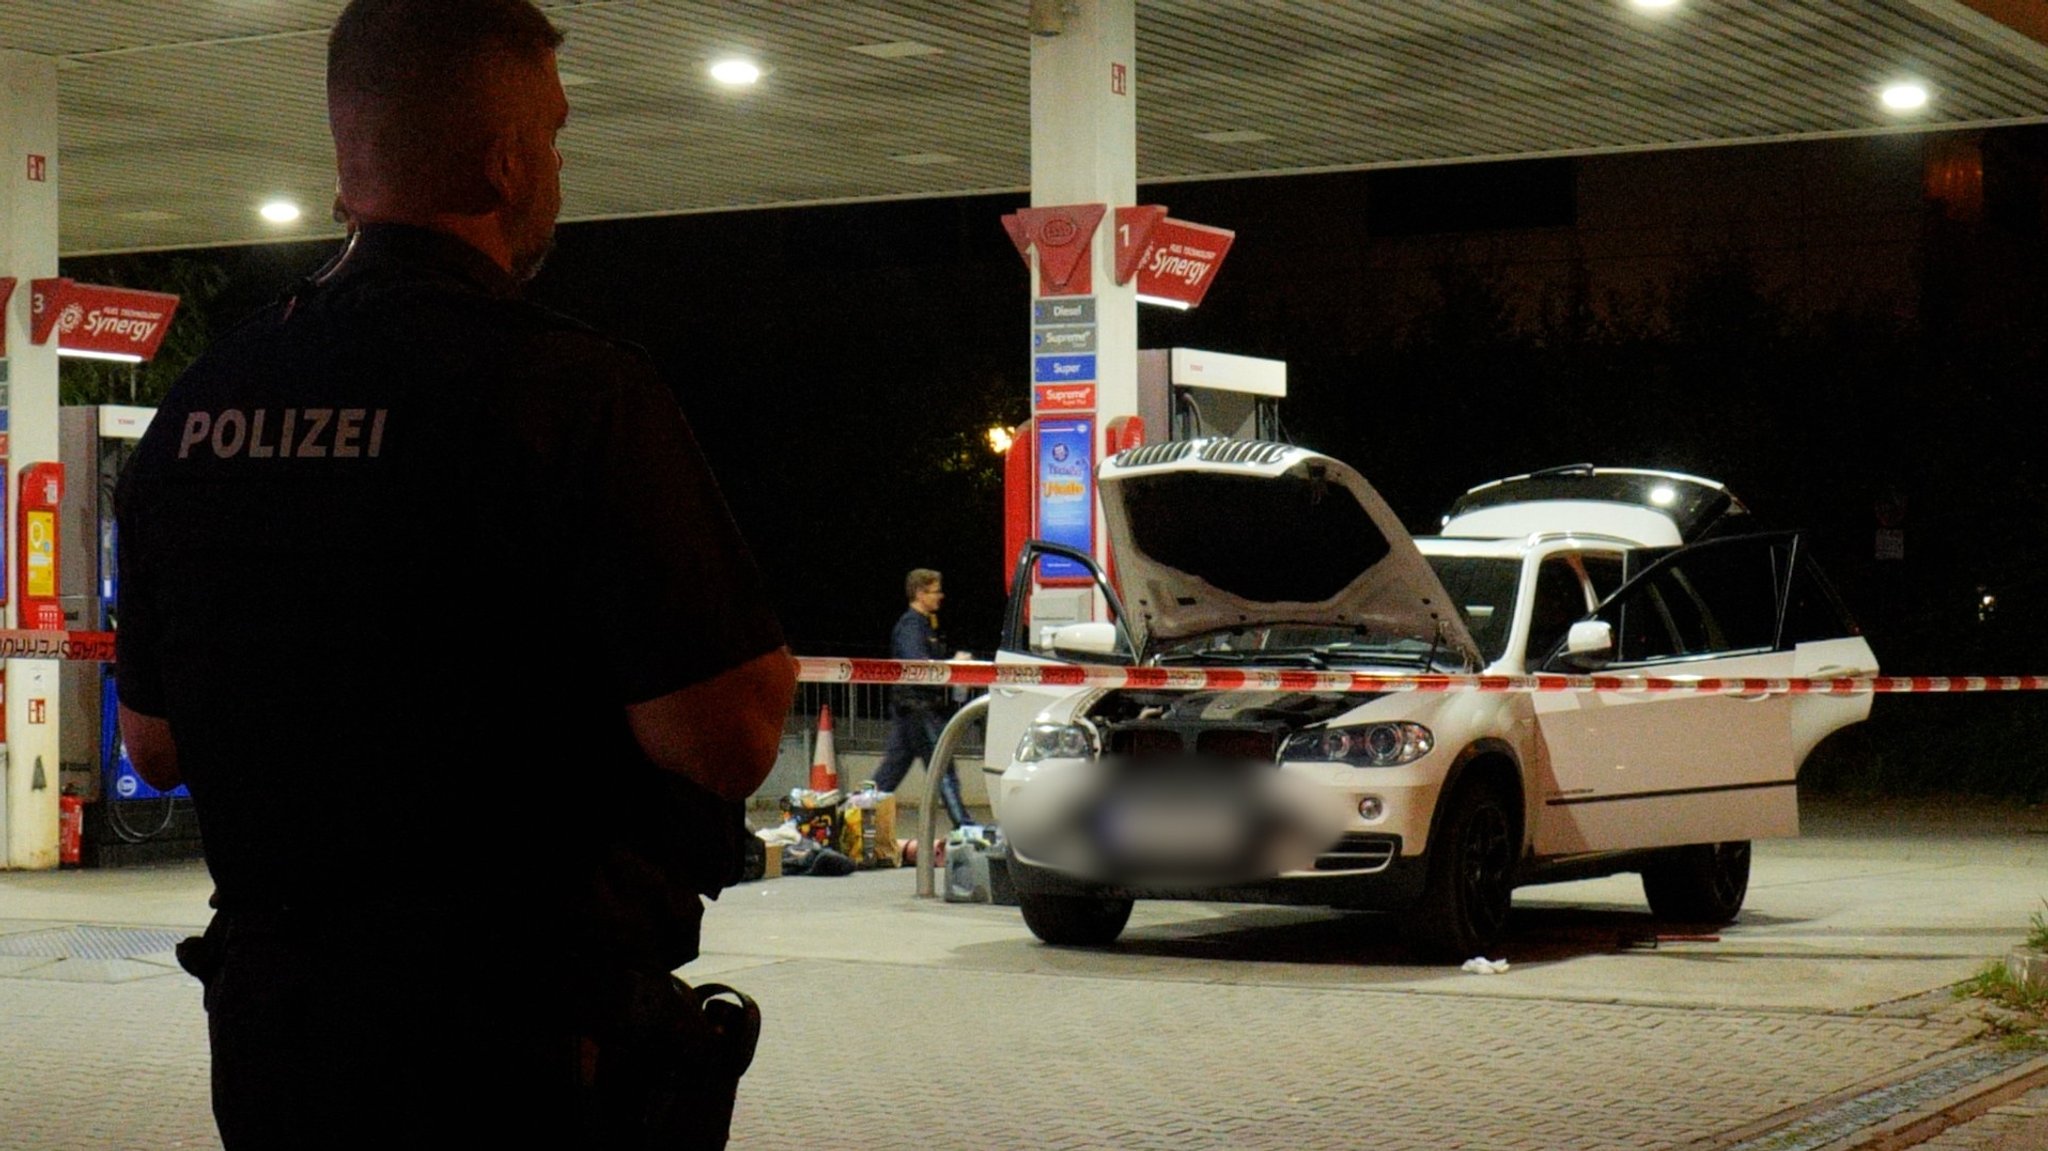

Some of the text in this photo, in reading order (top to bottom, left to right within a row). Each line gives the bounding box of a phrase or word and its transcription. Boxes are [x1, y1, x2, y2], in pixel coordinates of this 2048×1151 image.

[1119, 223, 1130, 247] 1
[1149, 247, 1211, 286] Synergy
[33, 293, 44, 314] 3
[1053, 305, 1082, 317] Diesel
[83, 309, 158, 342] Synergy
[1053, 362, 1081, 376] Super
[178, 408, 388, 459] POLIZEI
